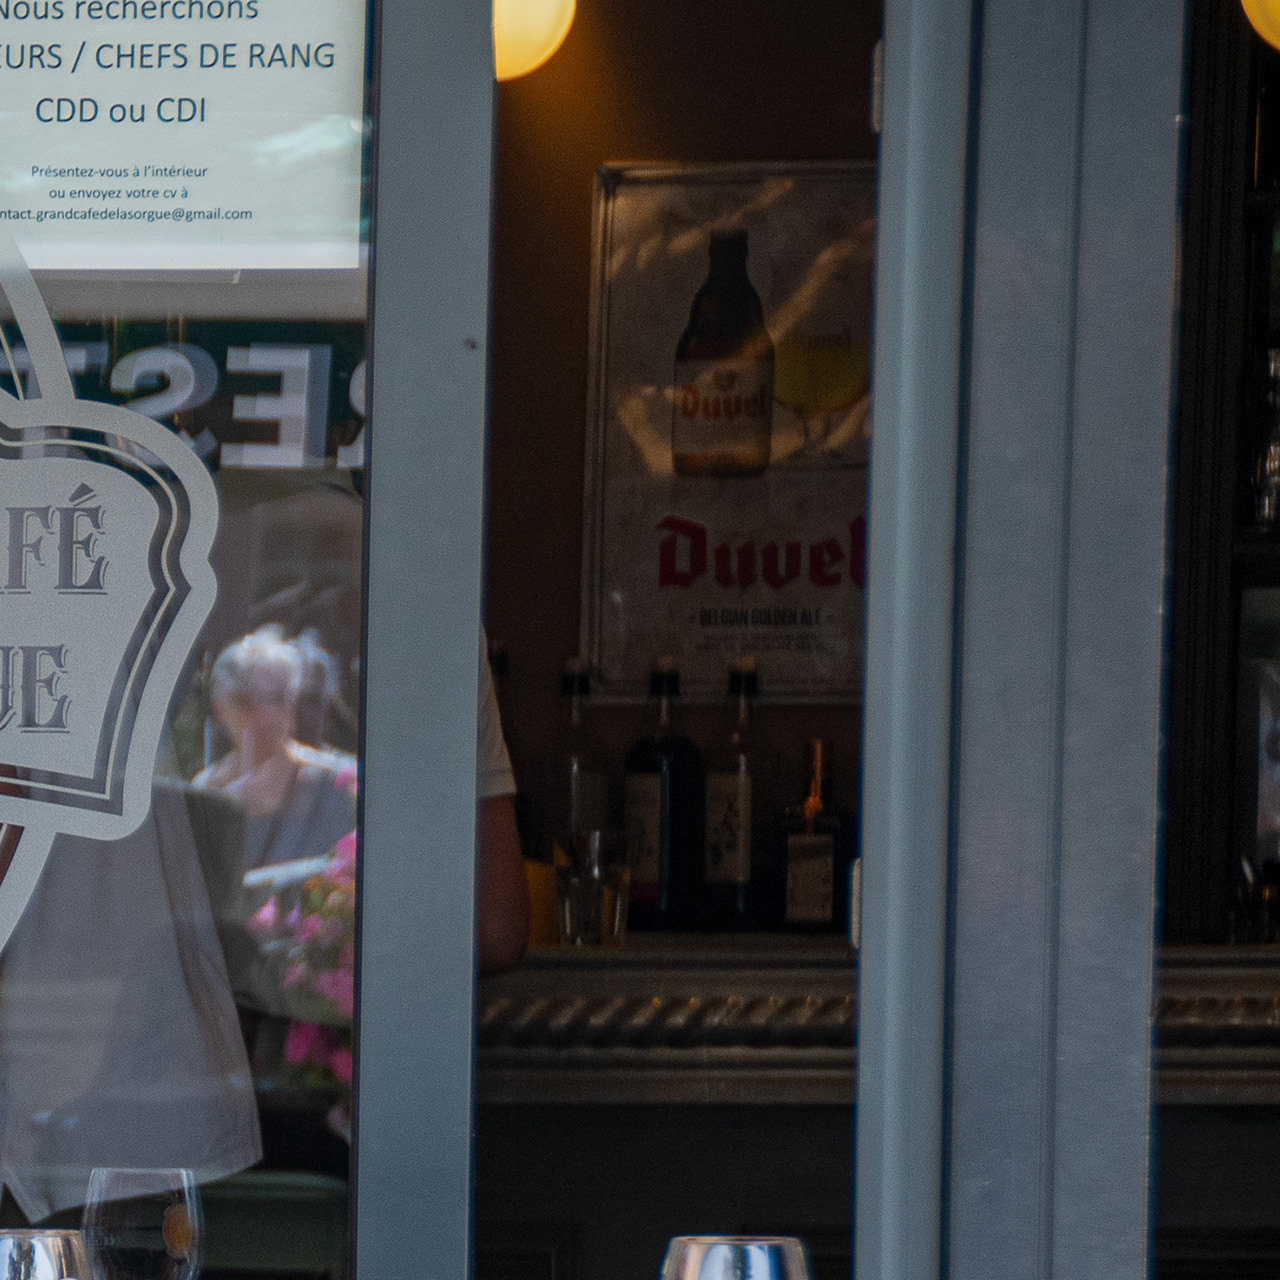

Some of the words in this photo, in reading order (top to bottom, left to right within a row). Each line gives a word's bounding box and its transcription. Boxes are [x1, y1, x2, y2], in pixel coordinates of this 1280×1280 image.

[75, 0, 259, 21] recherchons
[95, 42, 189, 70] CHEFS
[199, 43, 238, 70] DE
[248, 42, 335, 70] RANG
[35, 97, 99, 124] CDD
[108, 103, 146, 124] ou
[156, 97, 206, 124] CDI
[31, 165, 129, 178] Présentez-vous
[132, 165, 140, 177] à
[48, 188, 66, 200] ou
[69, 189, 122, 202] envoyez
[125, 187, 160, 200] votre
[162, 188, 178, 200] cv
[180, 187, 189, 200] à
[657, 514, 867, 590] Duvel
